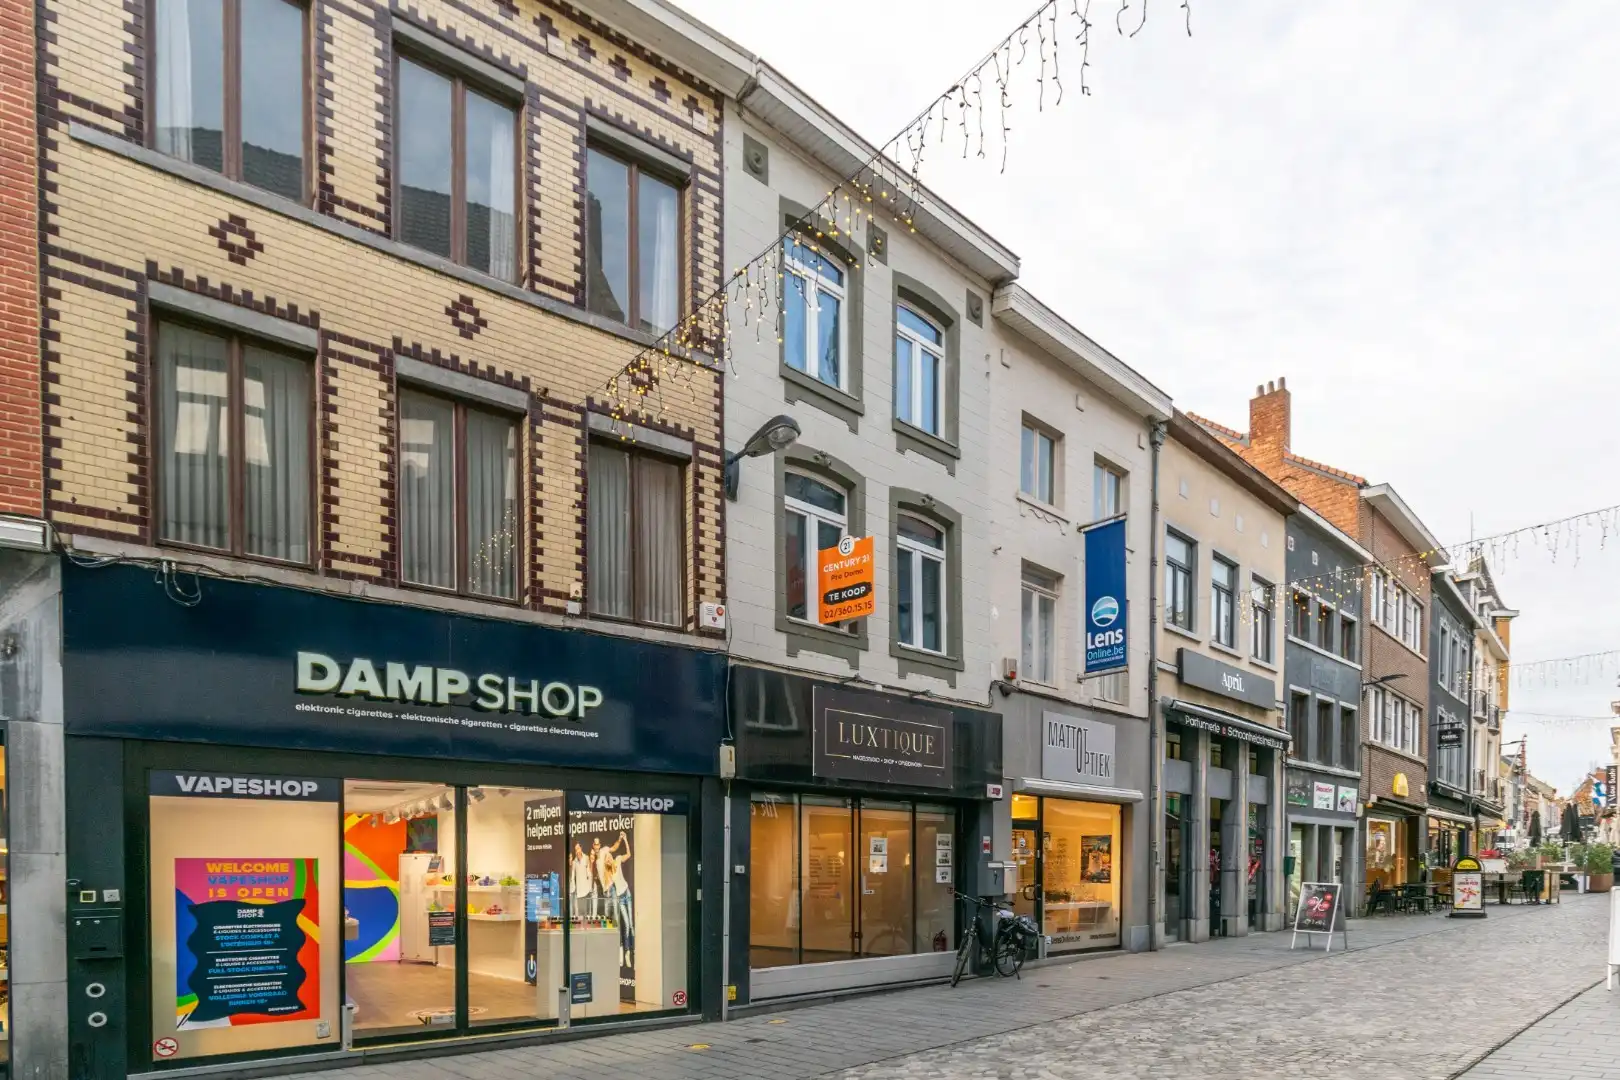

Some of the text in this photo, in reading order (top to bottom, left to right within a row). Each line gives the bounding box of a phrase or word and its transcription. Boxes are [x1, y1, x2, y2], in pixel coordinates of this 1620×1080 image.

[824, 557, 860, 573] CENTURY
[828, 586, 866, 602] TE KOOP
[824, 600, 872, 618] 02/360.15.15
[1087, 628, 1124, 650] Lens
[1087, 646, 1124, 660] Online.be
[298, 652, 604, 718] DAMPSHOP
[295, 703, 599, 738] elektronic cigarettes elektronische sigaretten cigarettes électroniques
[838, 721, 935, 755] LUXTIQUE
[1048, 722, 1088, 773] MATTOT
[176, 776, 318, 796] VAPESHOP
[584, 794, 674, 812] VAPESHOP
[526, 806, 532, 820] 2
[590, 817, 607, 832] met
[206, 862, 289, 872] WELCOME
[208, 888, 288, 898] IS OPEN
